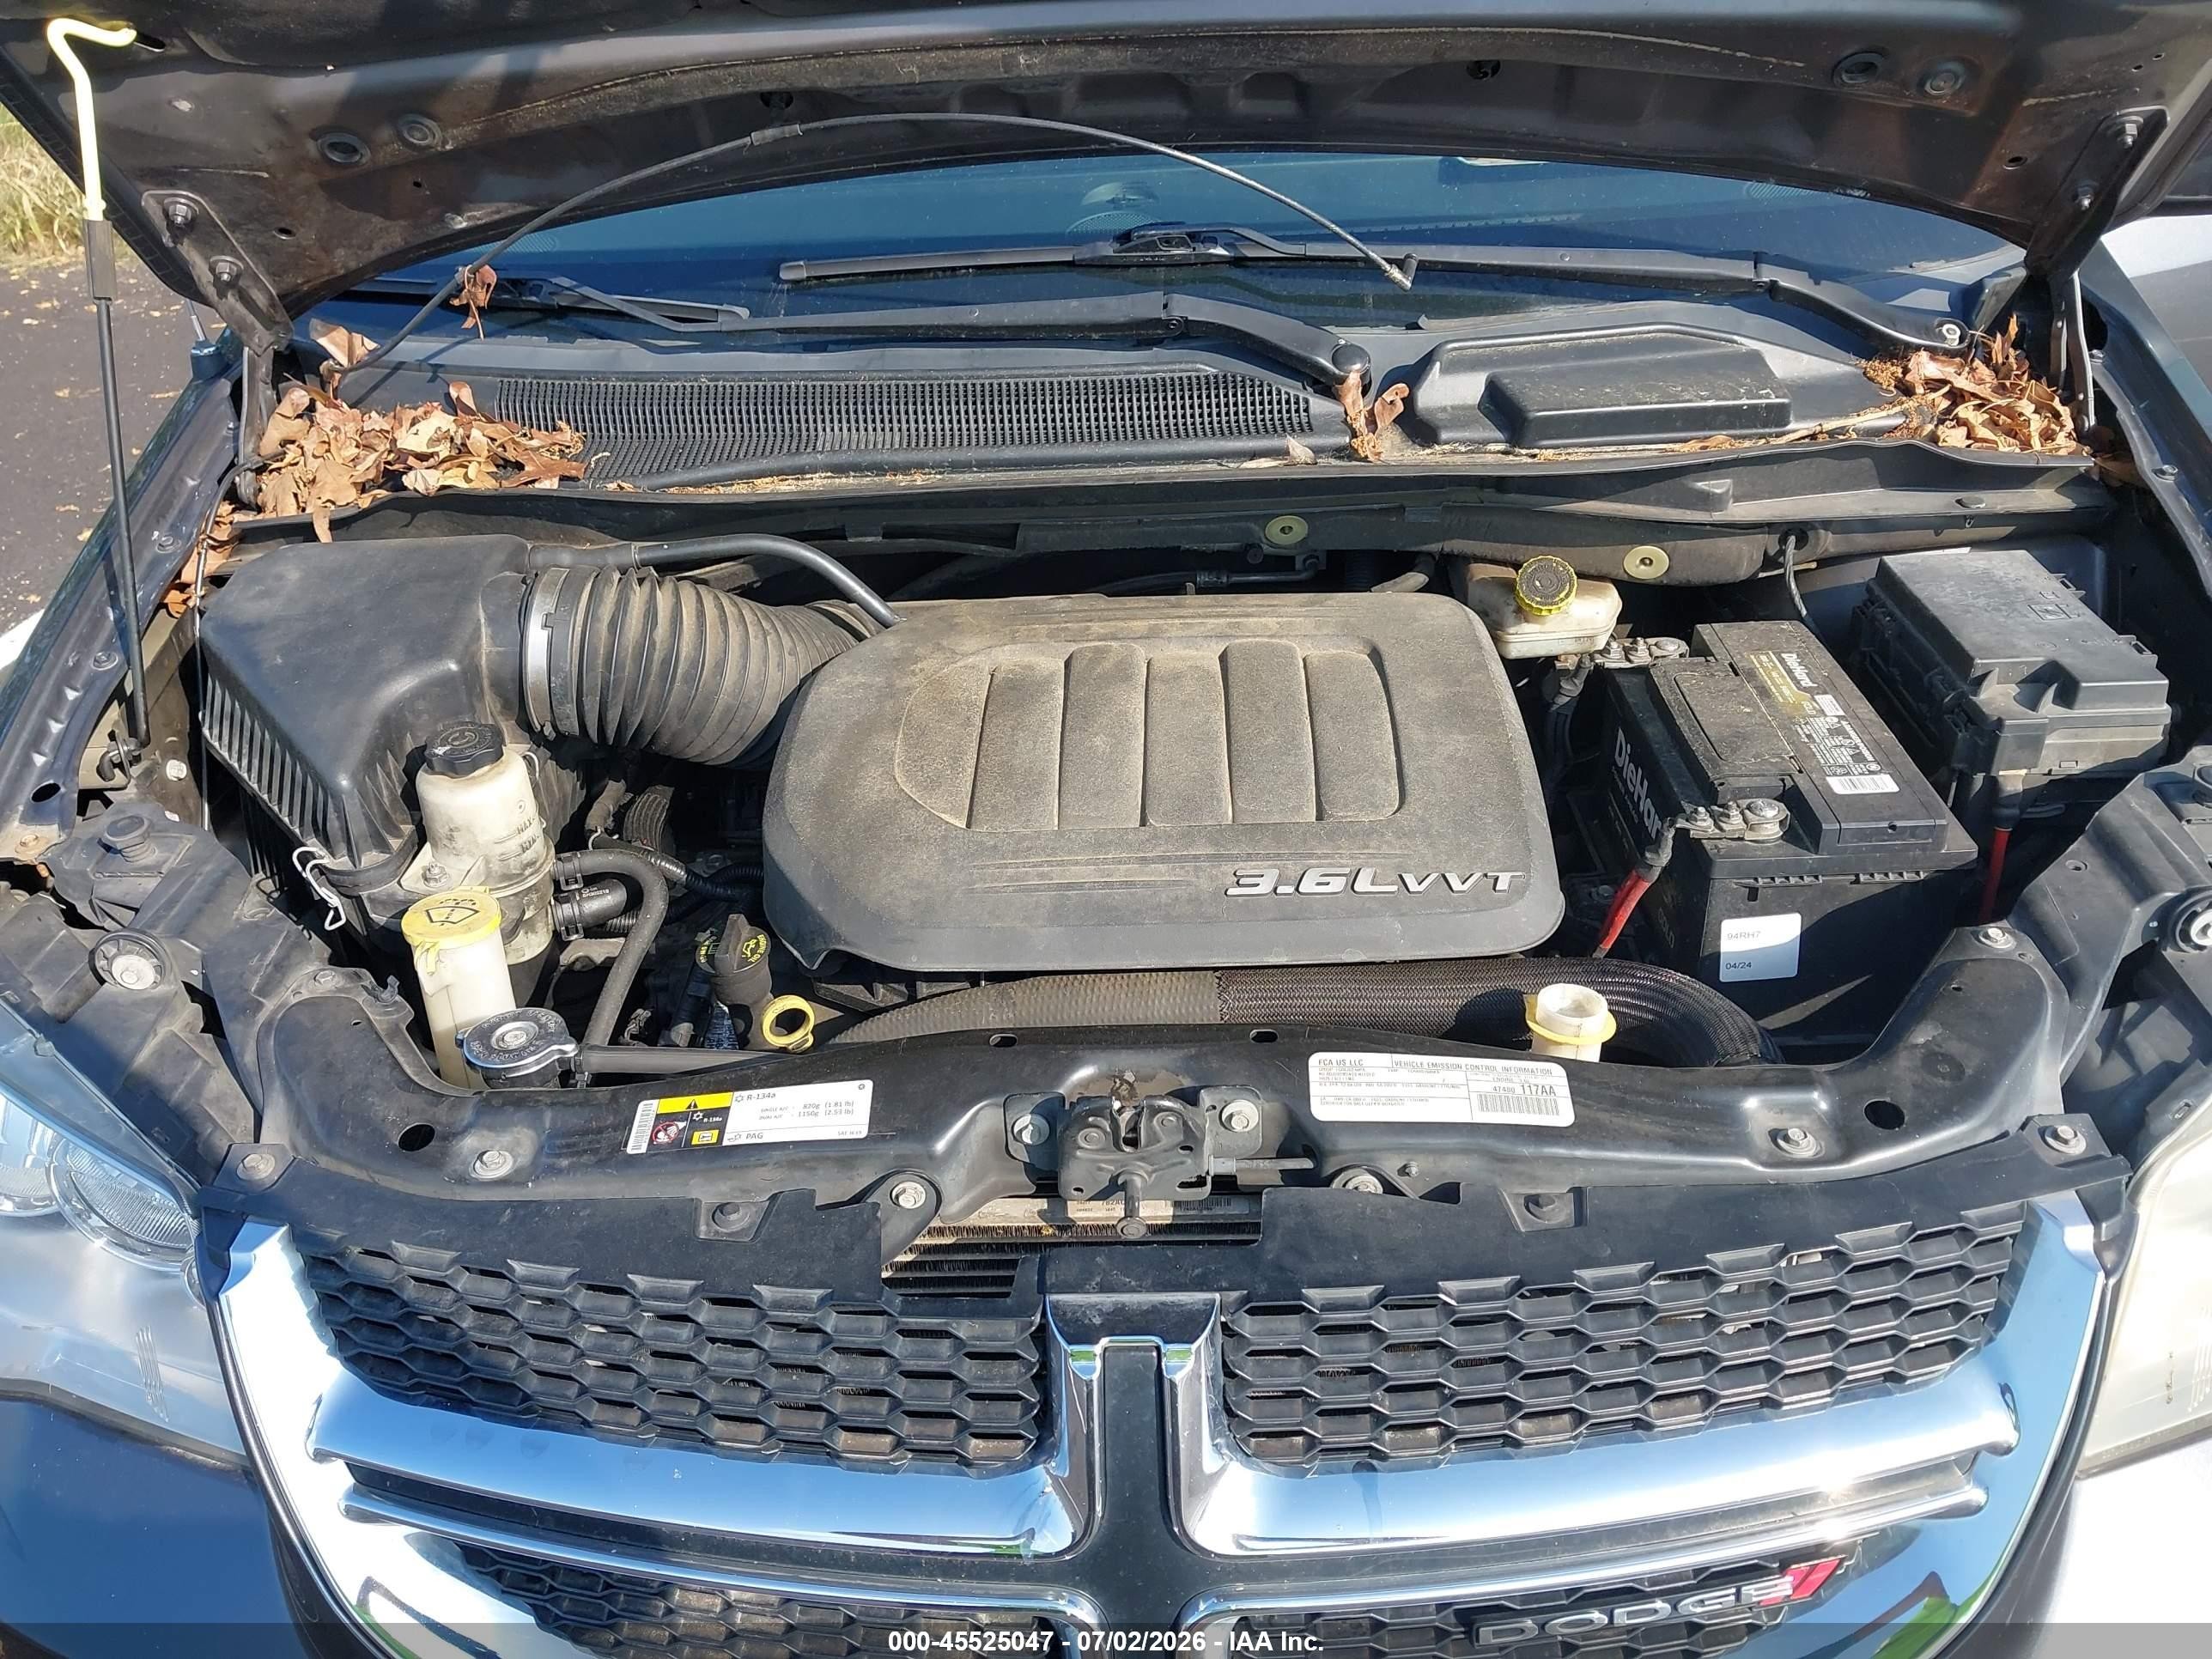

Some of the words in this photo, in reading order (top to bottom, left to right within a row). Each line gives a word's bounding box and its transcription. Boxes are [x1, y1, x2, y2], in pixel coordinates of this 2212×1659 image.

[1781, 653, 1818, 687] DieHard
[1614, 726, 1663, 841] DieHar
[1727, 931, 1761, 940] 94RH7
[756, 933, 767, 954] ENGINE
[747, 953, 762, 963] OIL
[1725, 961, 1753, 970] 04/24
[1394, 1060, 1425, 1069] VEHICLE
[1427, 1061, 1462, 1070] EMISSION
[1465, 1063, 1499, 1073] CONTROL
[1501, 1065, 1553, 1076] INFORMATION
[1520, 1083, 1557, 1097] 117AA
[746, 1091, 776, 1101] R-134a
[824, 1101, 842, 1109] (1.81
[798, 1109, 819, 1118] 1150g
[844, 1107, 854, 1115] lb)
[745, 1132, 763, 1140] PAG
[1477, 1575, 1794, 1647] DODGE
